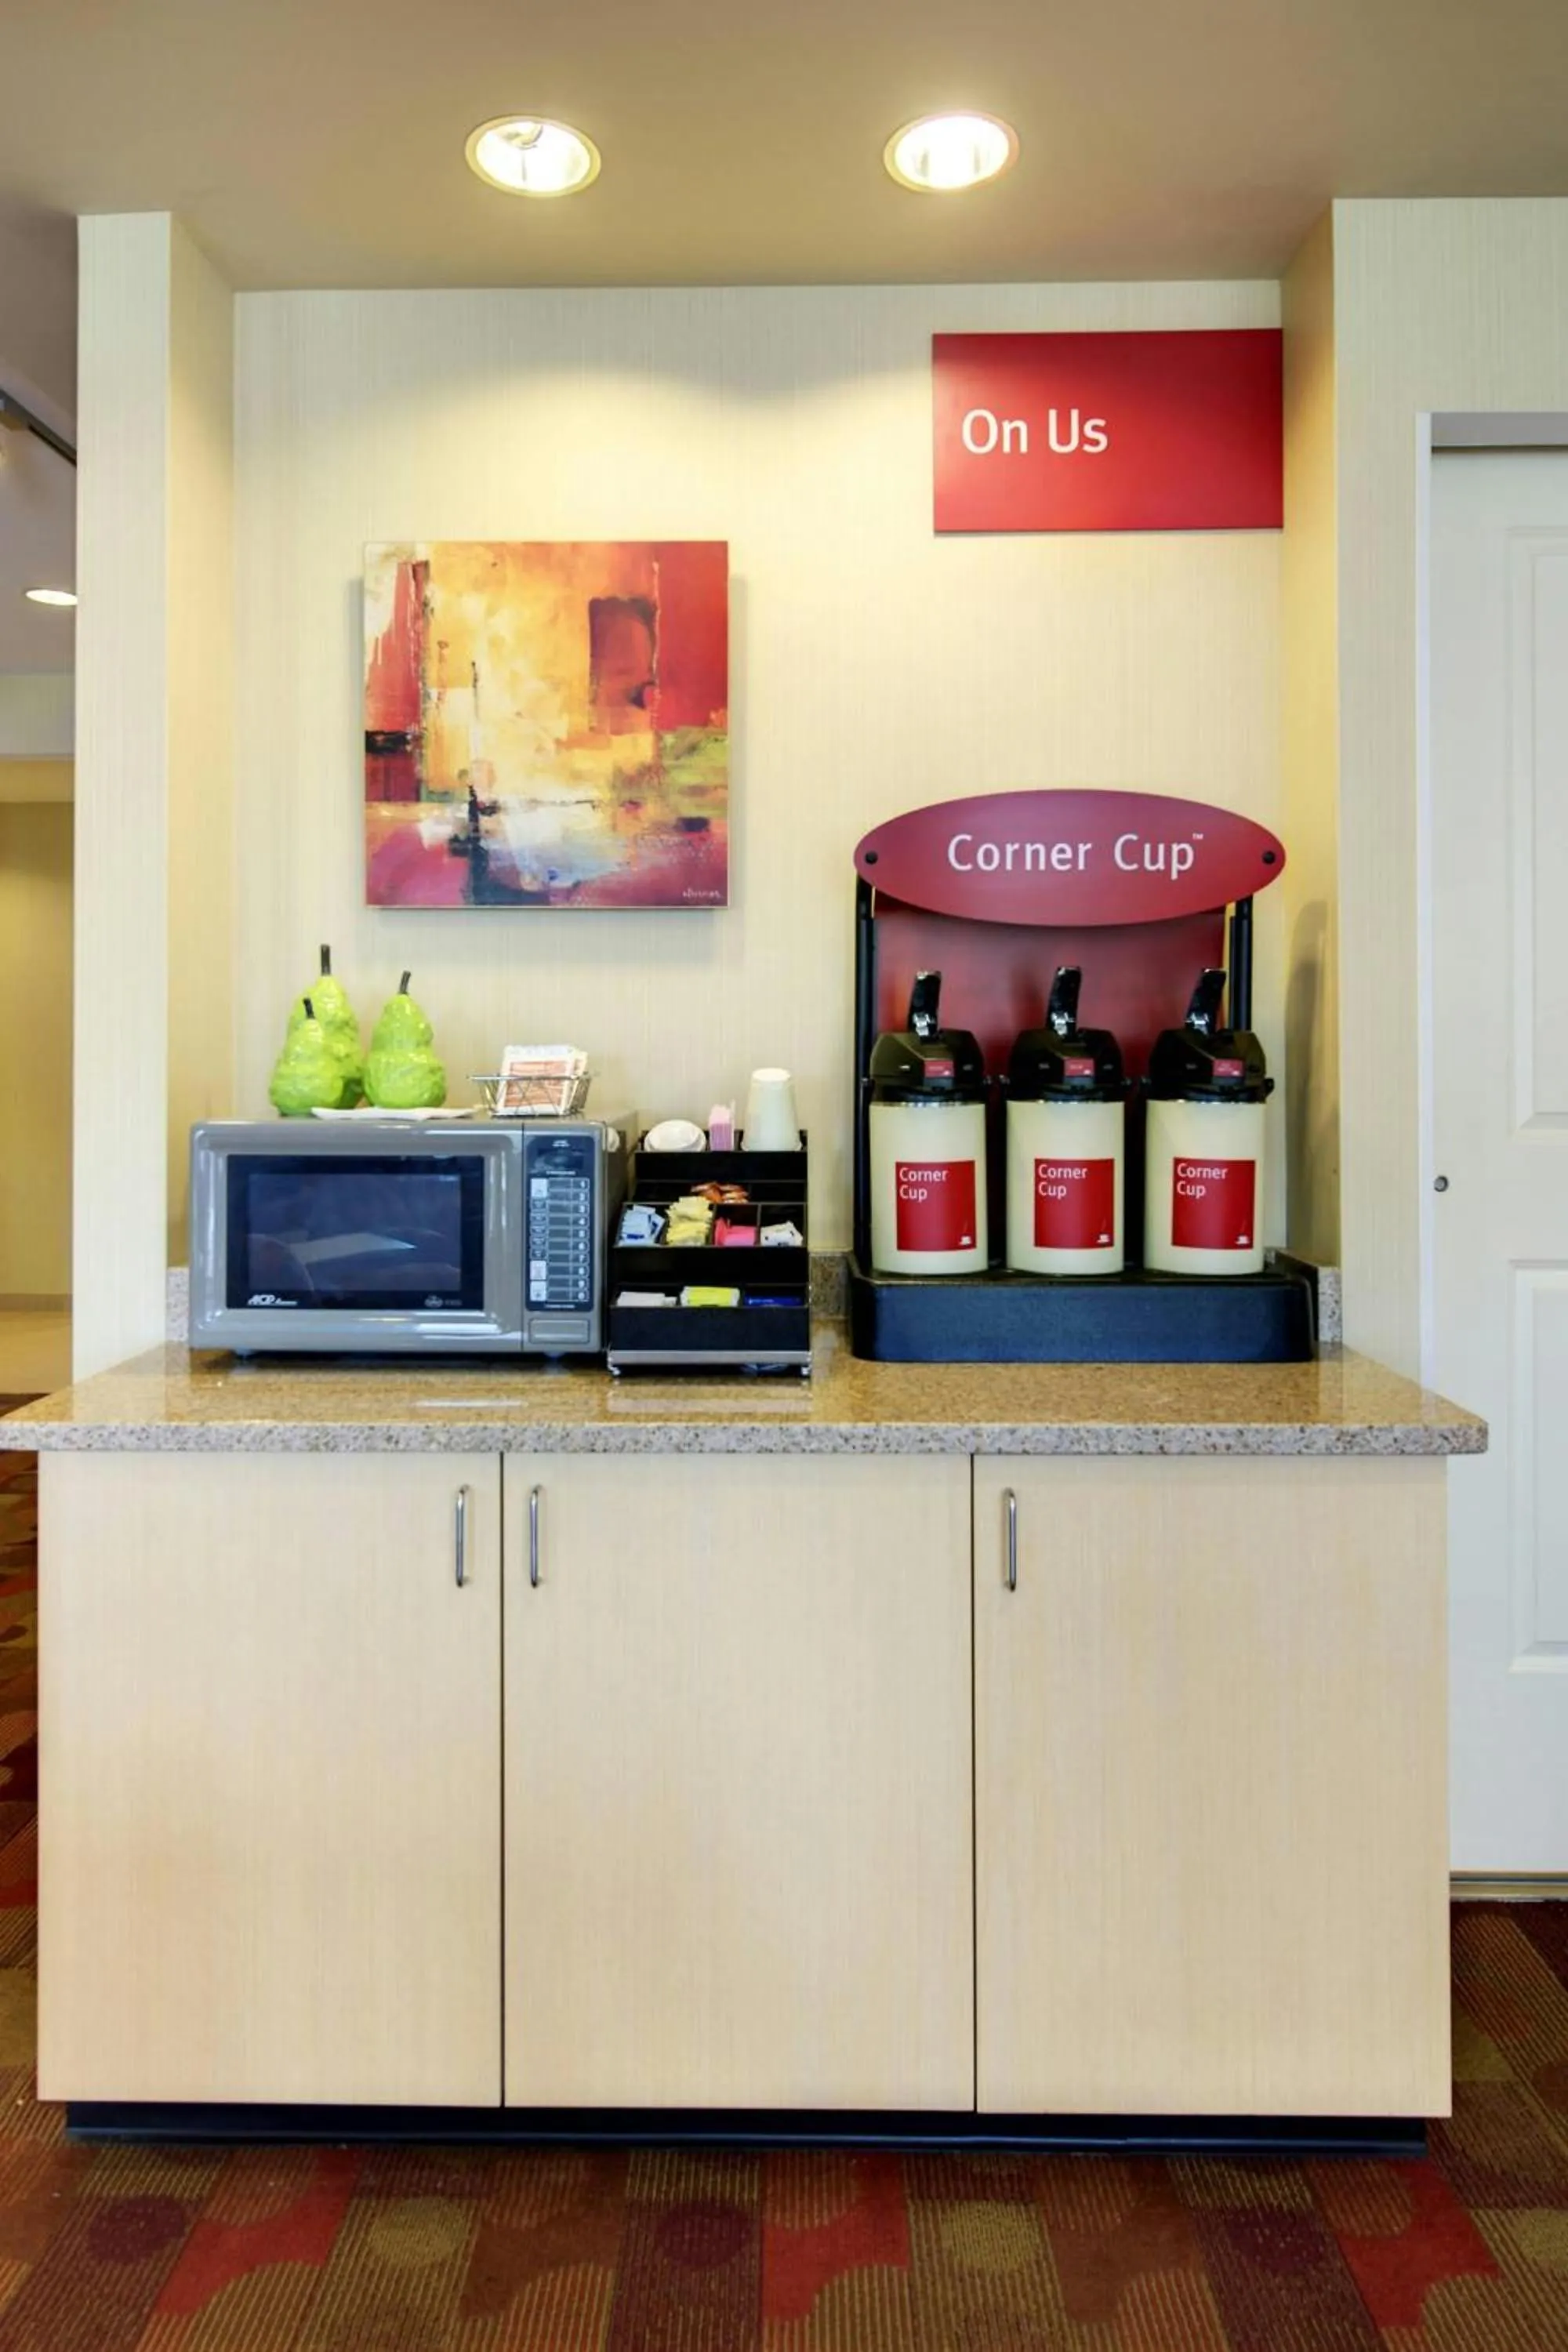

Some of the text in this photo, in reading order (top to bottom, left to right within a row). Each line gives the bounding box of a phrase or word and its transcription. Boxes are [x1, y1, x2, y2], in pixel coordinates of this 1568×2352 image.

[961, 408, 1109, 454] On Us
[947, 833, 1093, 871] Corner
[898, 1167, 949, 1182] Corner
[1038, 1163, 1088, 1179] Corner
[1177, 1163, 1229, 1179] Corner
[898, 1184, 928, 1203] Cup
[1038, 1181, 1067, 1200] Cup
[1176, 1180, 1207, 1200] Cup
